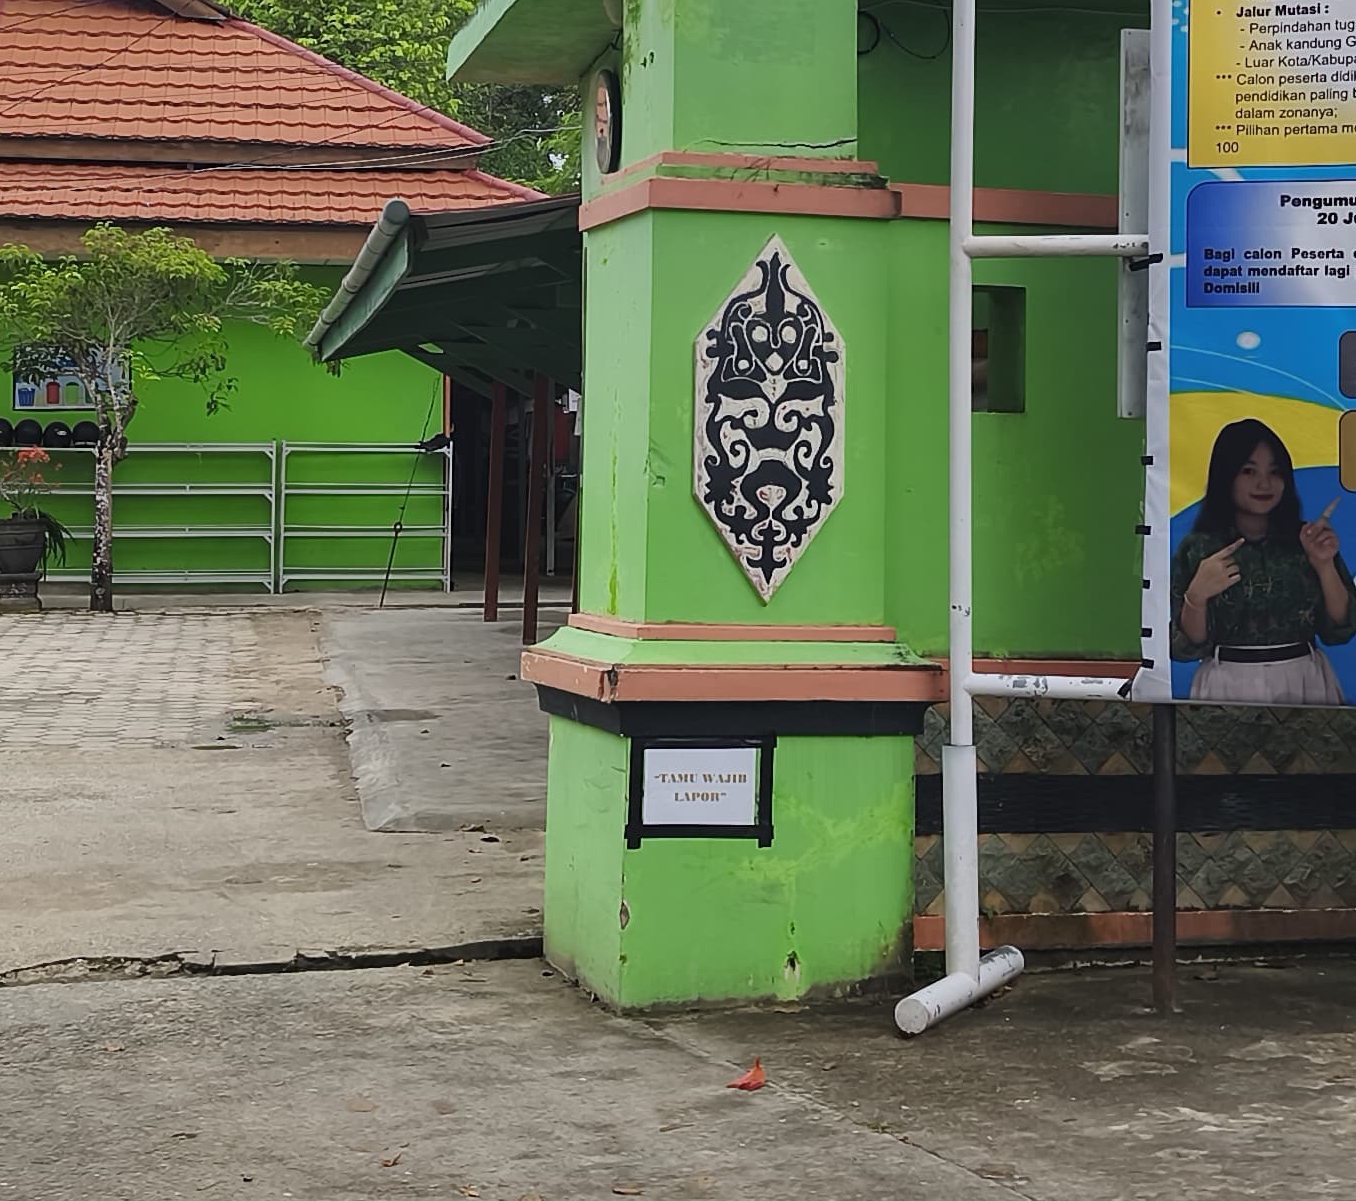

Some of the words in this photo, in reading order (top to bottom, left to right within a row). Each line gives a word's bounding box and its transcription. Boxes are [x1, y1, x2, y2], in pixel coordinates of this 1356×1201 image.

[1236, 5, 1271, 18] Jalur
[1275, 2, 1321, 16] Mutasi
[1317, 213, 1338, 225] 20
[702, 774, 747, 783] WAJIB
